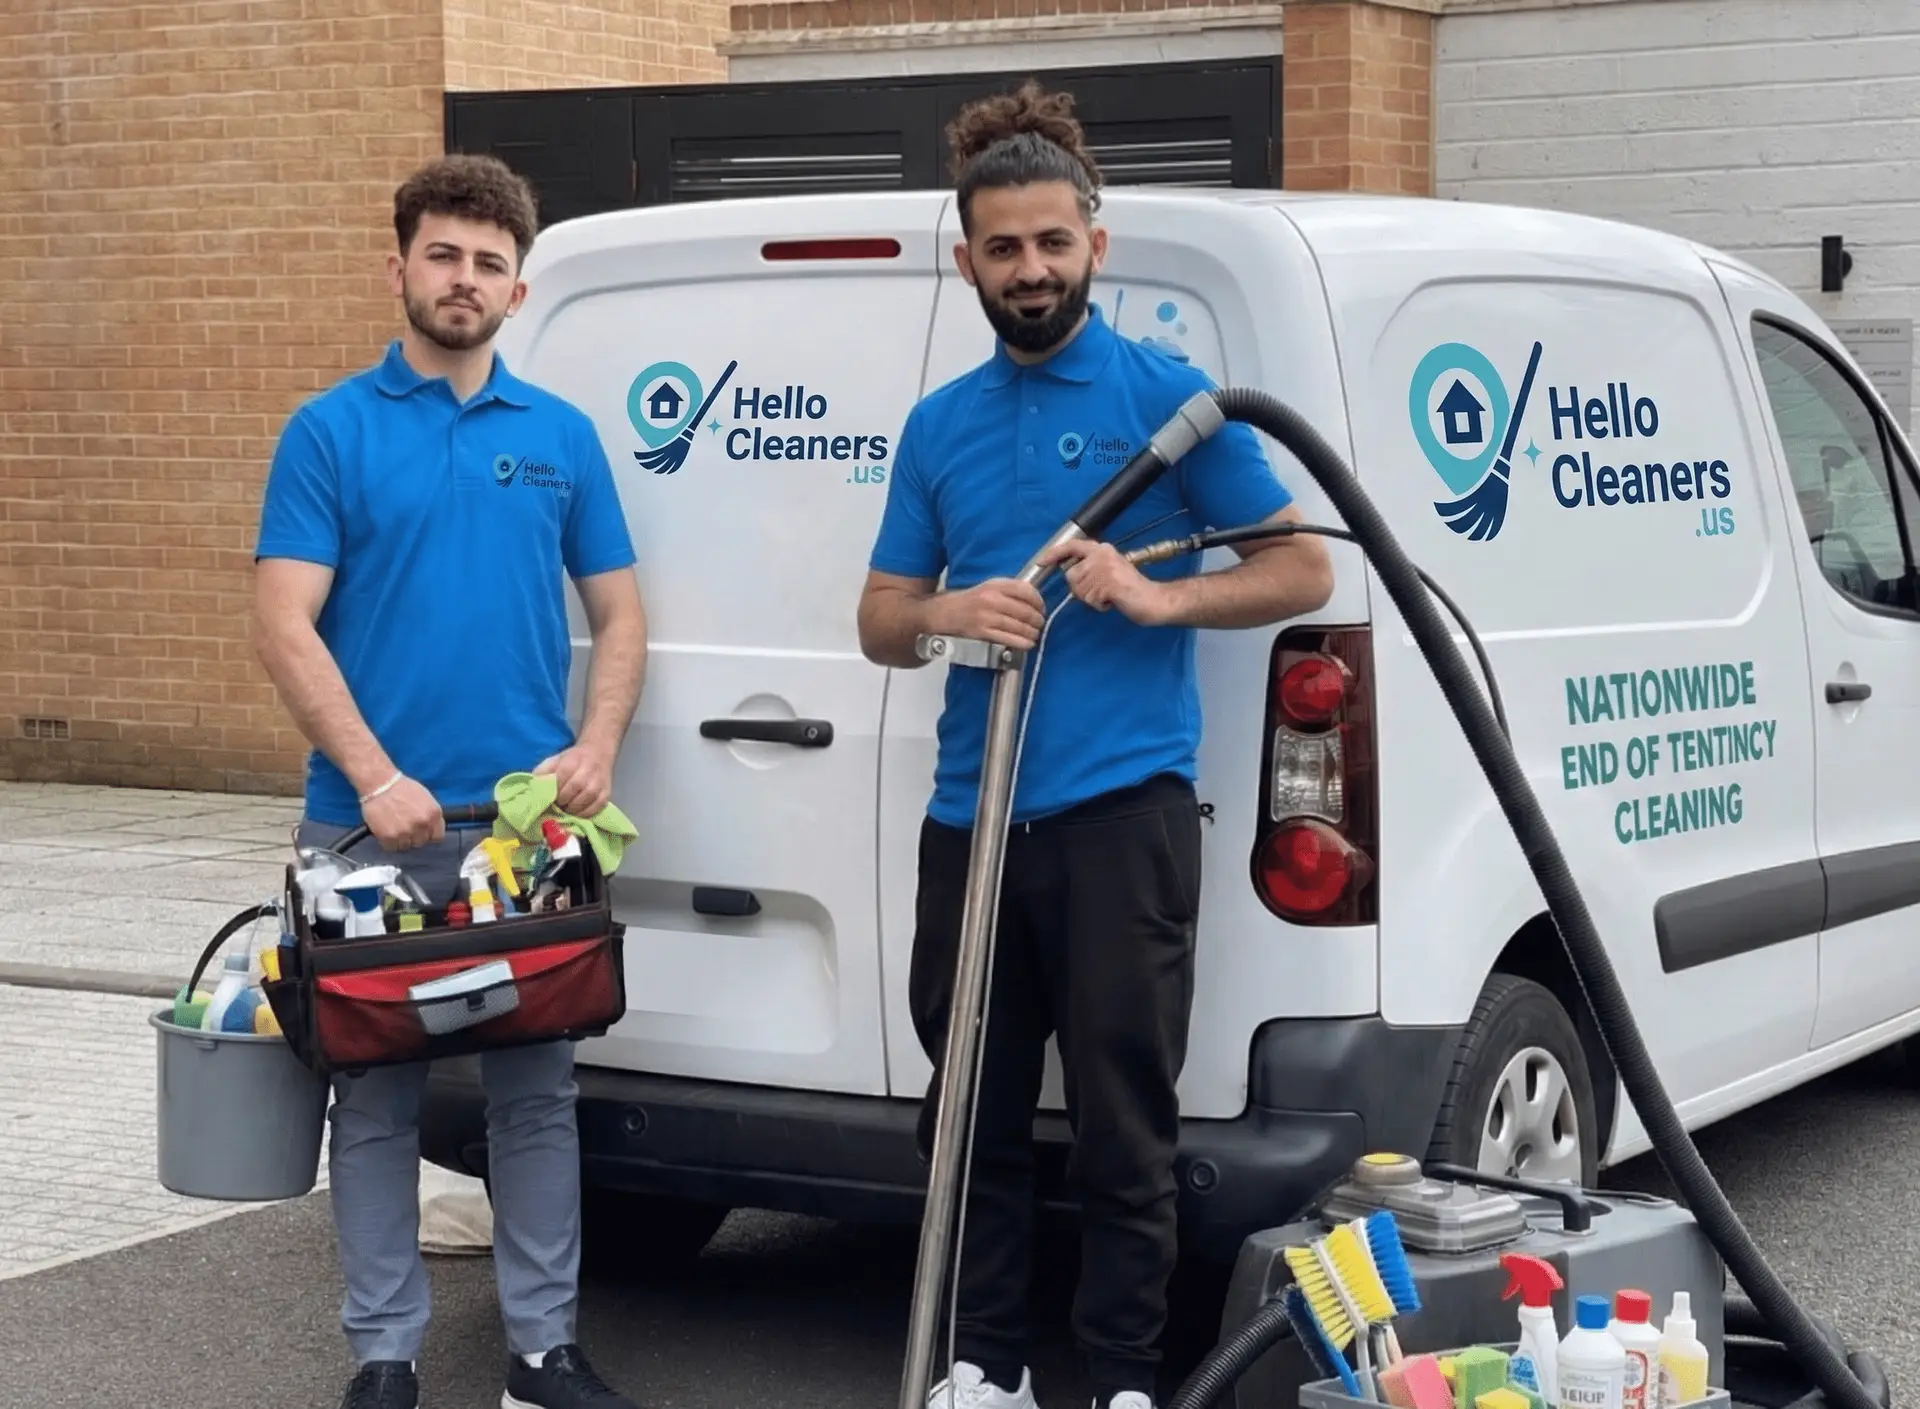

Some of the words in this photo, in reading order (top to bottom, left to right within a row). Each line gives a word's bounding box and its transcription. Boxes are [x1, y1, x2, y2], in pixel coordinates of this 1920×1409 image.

[733, 385, 828, 420] Hello
[1548, 382, 1660, 440] Hello
[725, 426, 888, 461] Cleaners
[1093, 453, 1131, 465] Clean
[1094, 438, 1129, 452] Hello
[522, 475, 572, 490] Cleaners
[524, 462, 556, 476] Hello
[846, 465, 886, 484] .us
[1551, 451, 1732, 509] Cleaners
[1695, 507, 1736, 538] .us
[1564, 660, 1757, 726] NATIONWIDE
[1560, 741, 1620, 790] END
[1625, 734, 1660, 780] OF
[1666, 719, 1778, 773] TENTINCY
[1614, 782, 1744, 845] CLEANING
